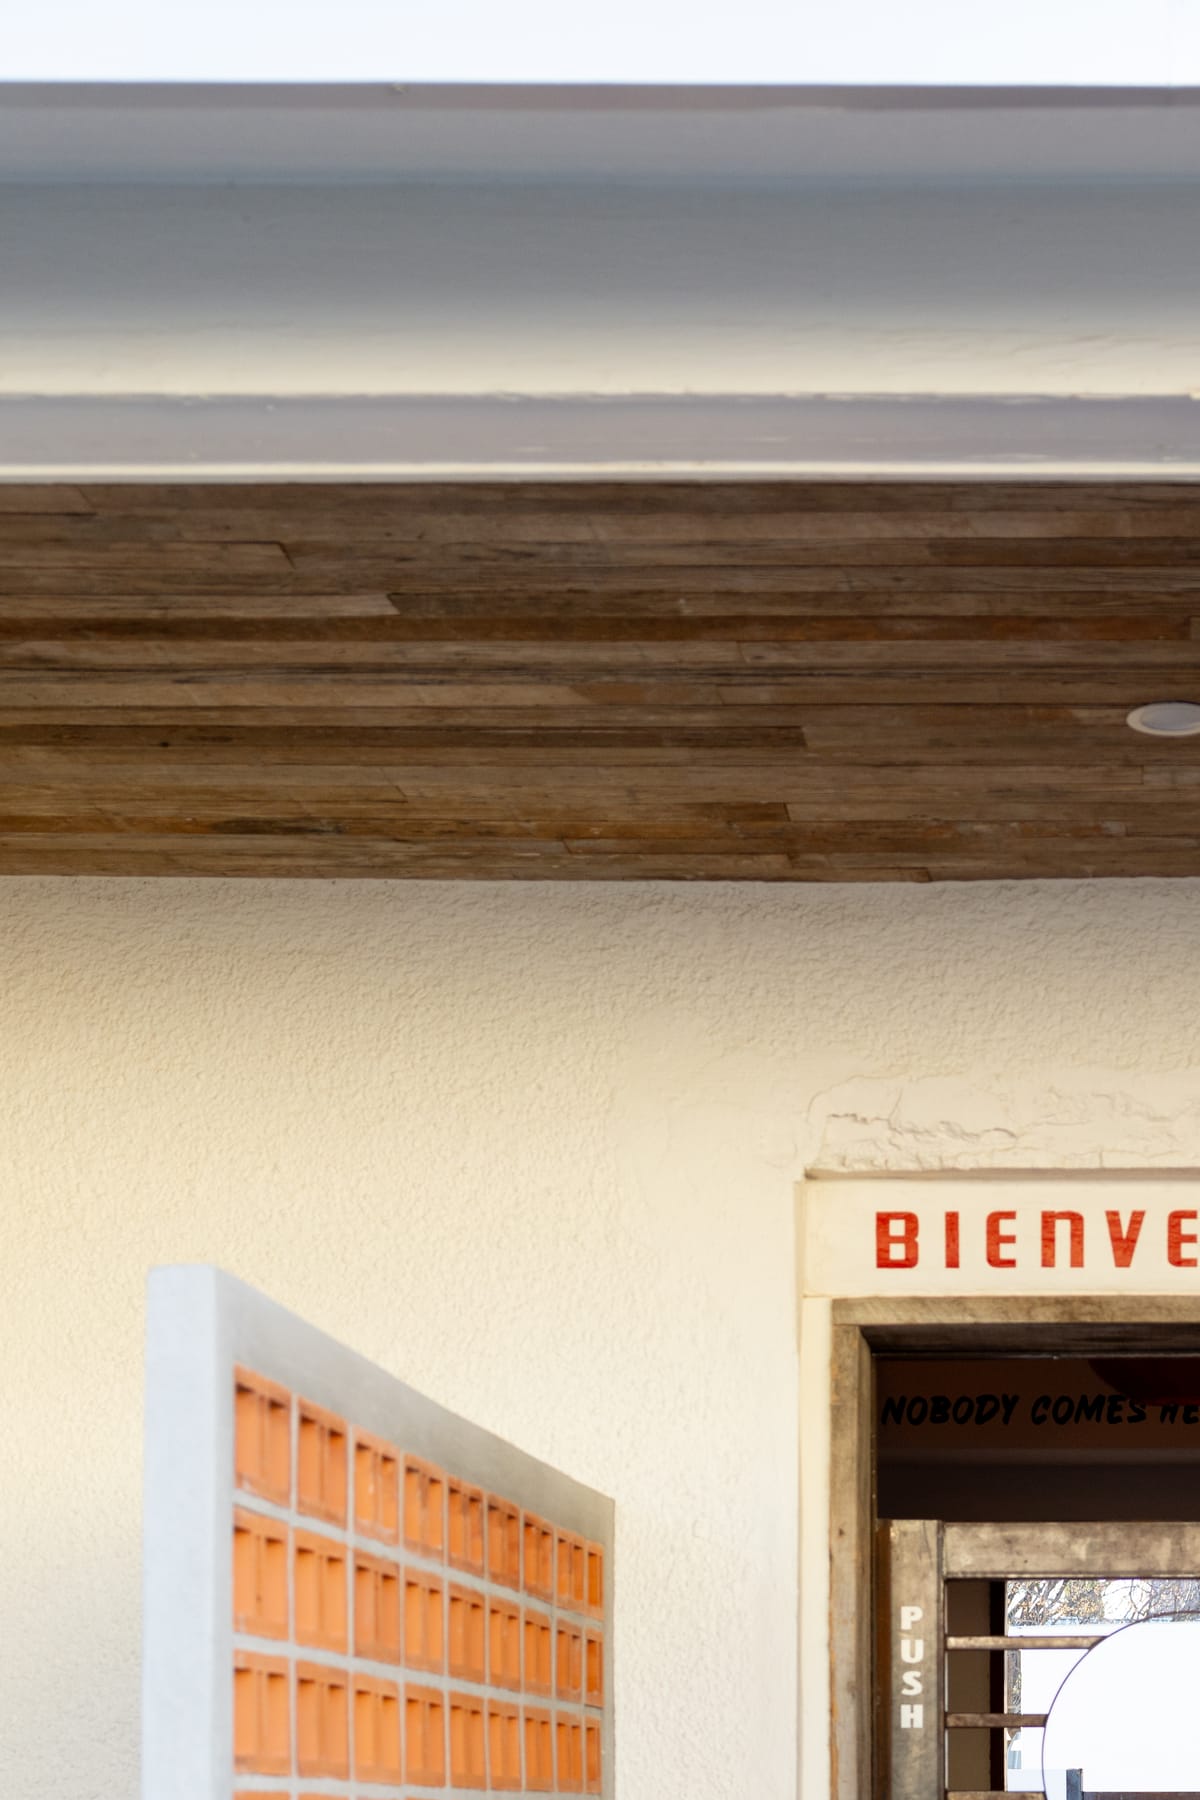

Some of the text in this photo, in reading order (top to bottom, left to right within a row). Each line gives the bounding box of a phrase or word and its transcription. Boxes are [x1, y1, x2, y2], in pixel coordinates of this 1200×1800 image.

[881, 1394, 1018, 1425] NOBODY
[1031, 1394, 1147, 1424] COMES
[900, 1606, 924, 1729] PUSH
